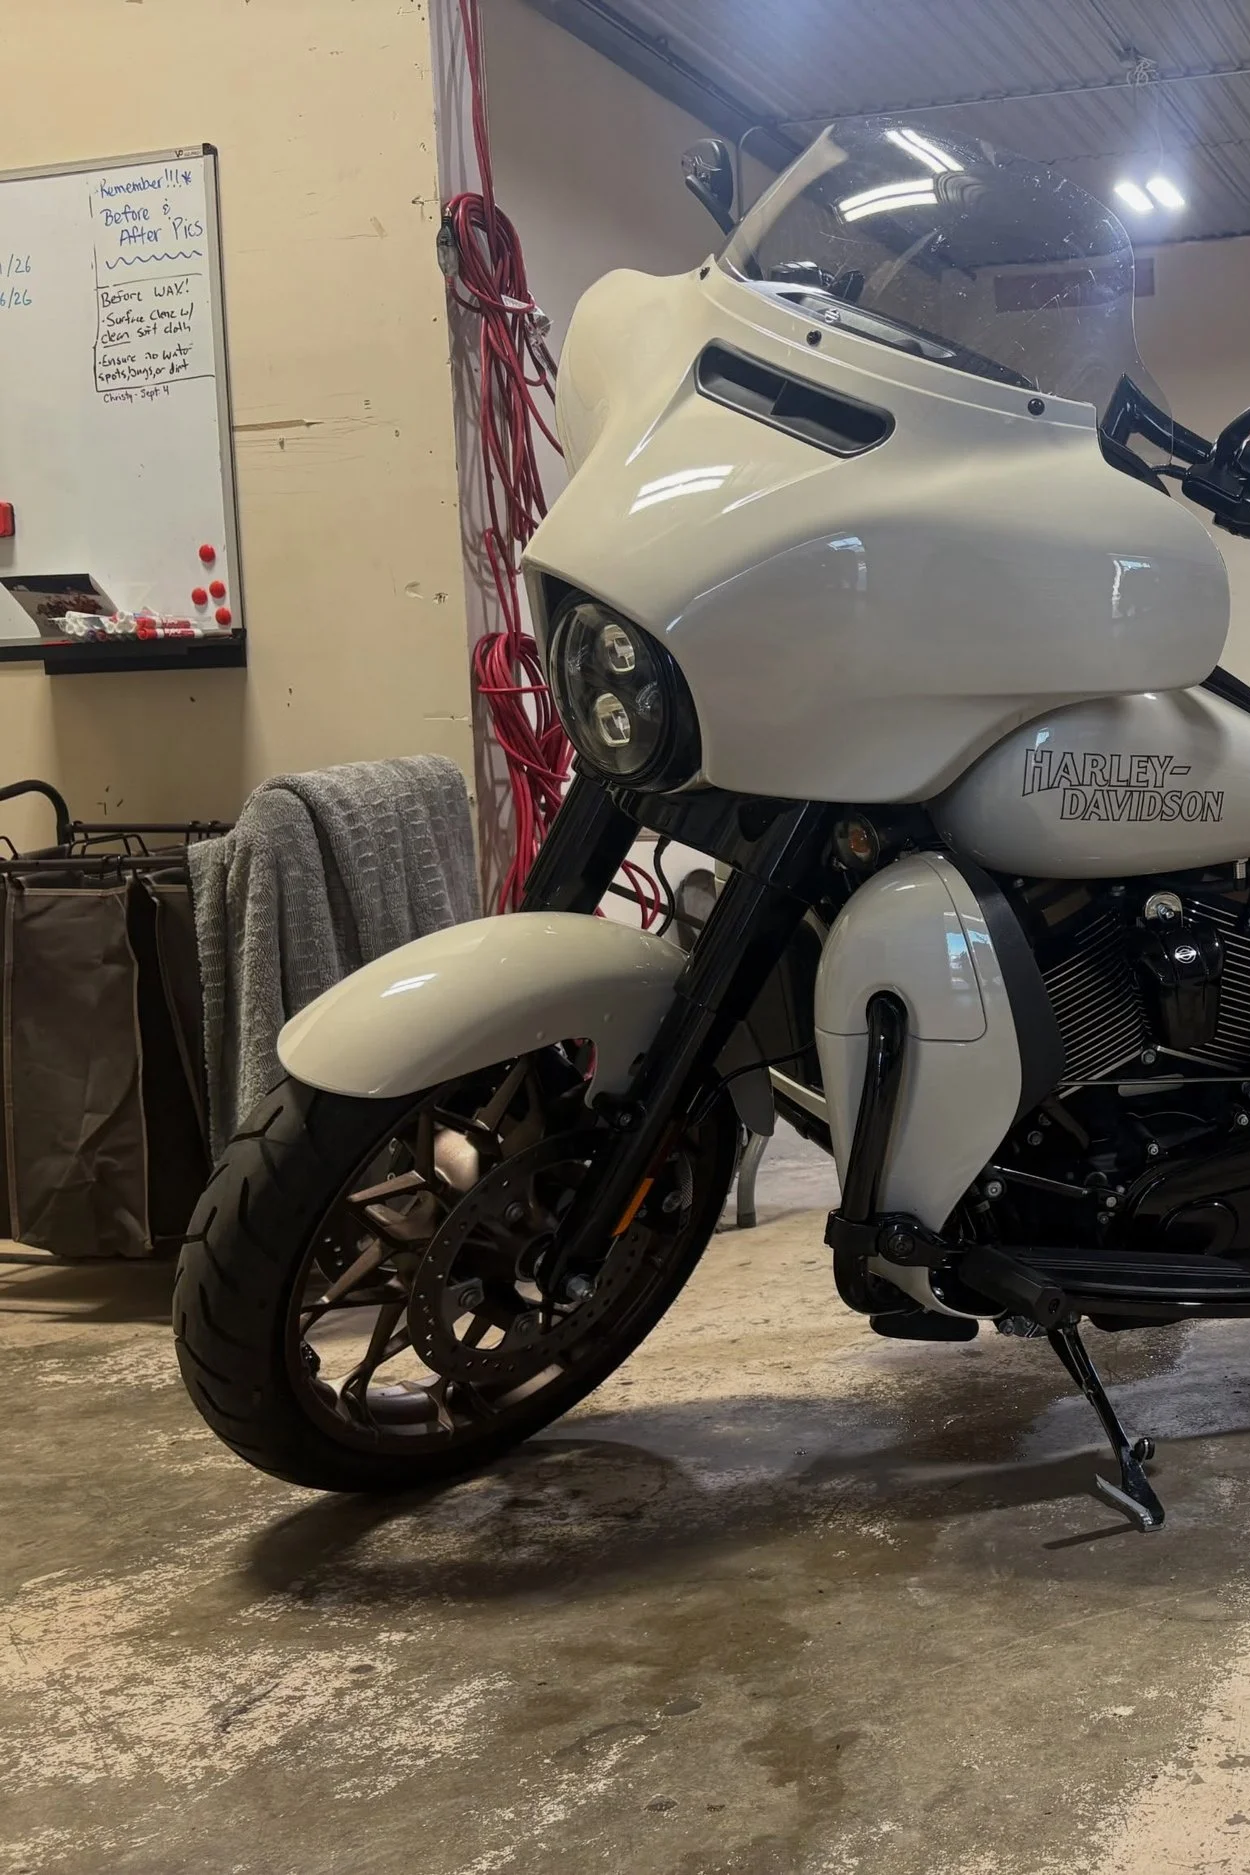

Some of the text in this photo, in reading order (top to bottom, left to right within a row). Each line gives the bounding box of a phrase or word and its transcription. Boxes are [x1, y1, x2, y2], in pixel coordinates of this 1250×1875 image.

[100, 204, 150, 226] Before
[119, 216, 203, 246] After Pics
[101, 290, 143, 308] Before
[101, 330, 130, 344] clean
[163, 321, 191, 334] cloth
[102, 354, 136, 367] Ensure
[168, 358, 189, 375] dirt
[162, 385, 170, 396] 4
[1022, 748, 1192, 797] HARLEY-
[1060, 787, 1224, 822] DAVIDSON
